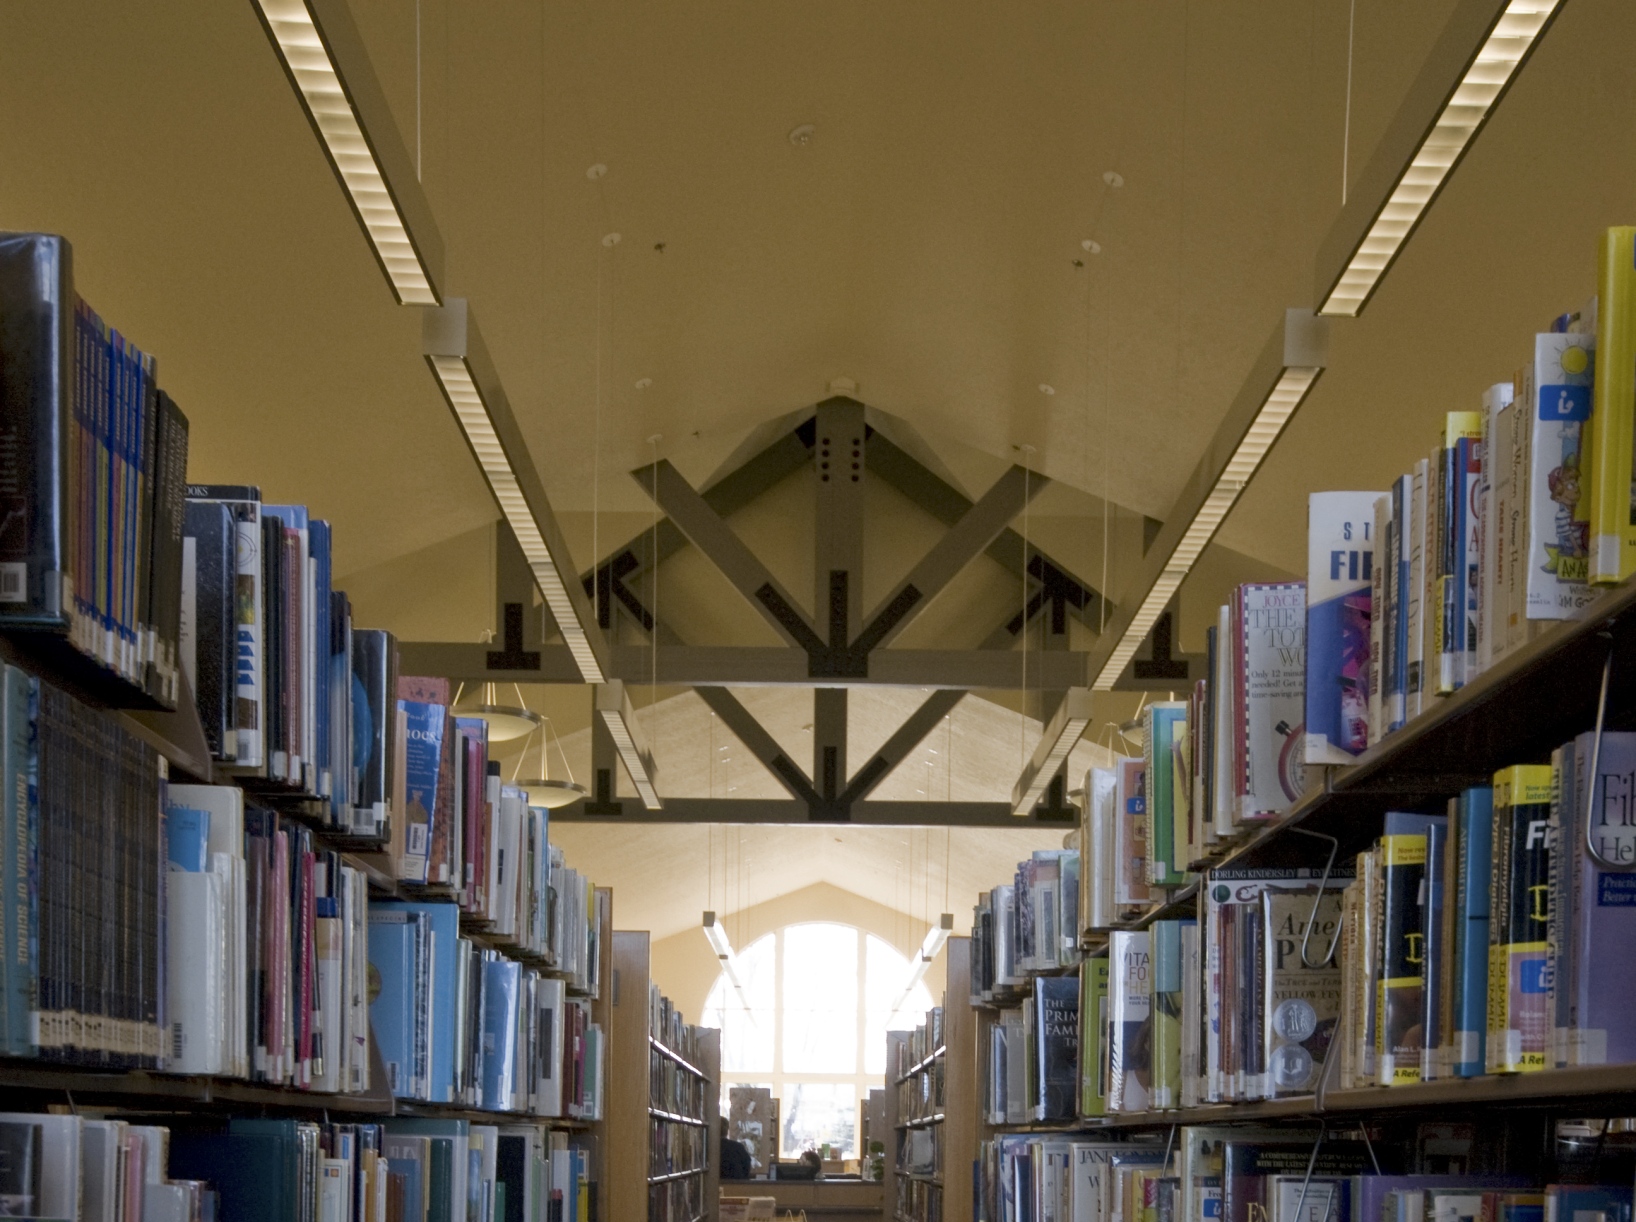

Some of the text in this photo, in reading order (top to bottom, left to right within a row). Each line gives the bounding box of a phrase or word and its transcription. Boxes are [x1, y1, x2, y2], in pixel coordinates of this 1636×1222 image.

[1250, 608, 1297, 628] THE
[1251, 670, 1268, 679] Only
[1272, 670, 1281, 678] 12
[1251, 679, 1280, 688] needed!
[1282, 679, 1296, 687] Get
[1251, 689, 1290, 699] time-saving
[1211, 867, 1295, 879] DORLING KINDERSLEY
[1500, 826, 1510, 926] Fibromyalgia
[17, 882, 28, 903] OF
[1490, 867, 1499, 941] Diabetes
[1377, 878, 1385, 971] Diabetes
[17, 904, 28, 966] SCIENCE
[1274, 991, 1317, 999] YELLOW
[1045, 999, 1066, 1008] THE
